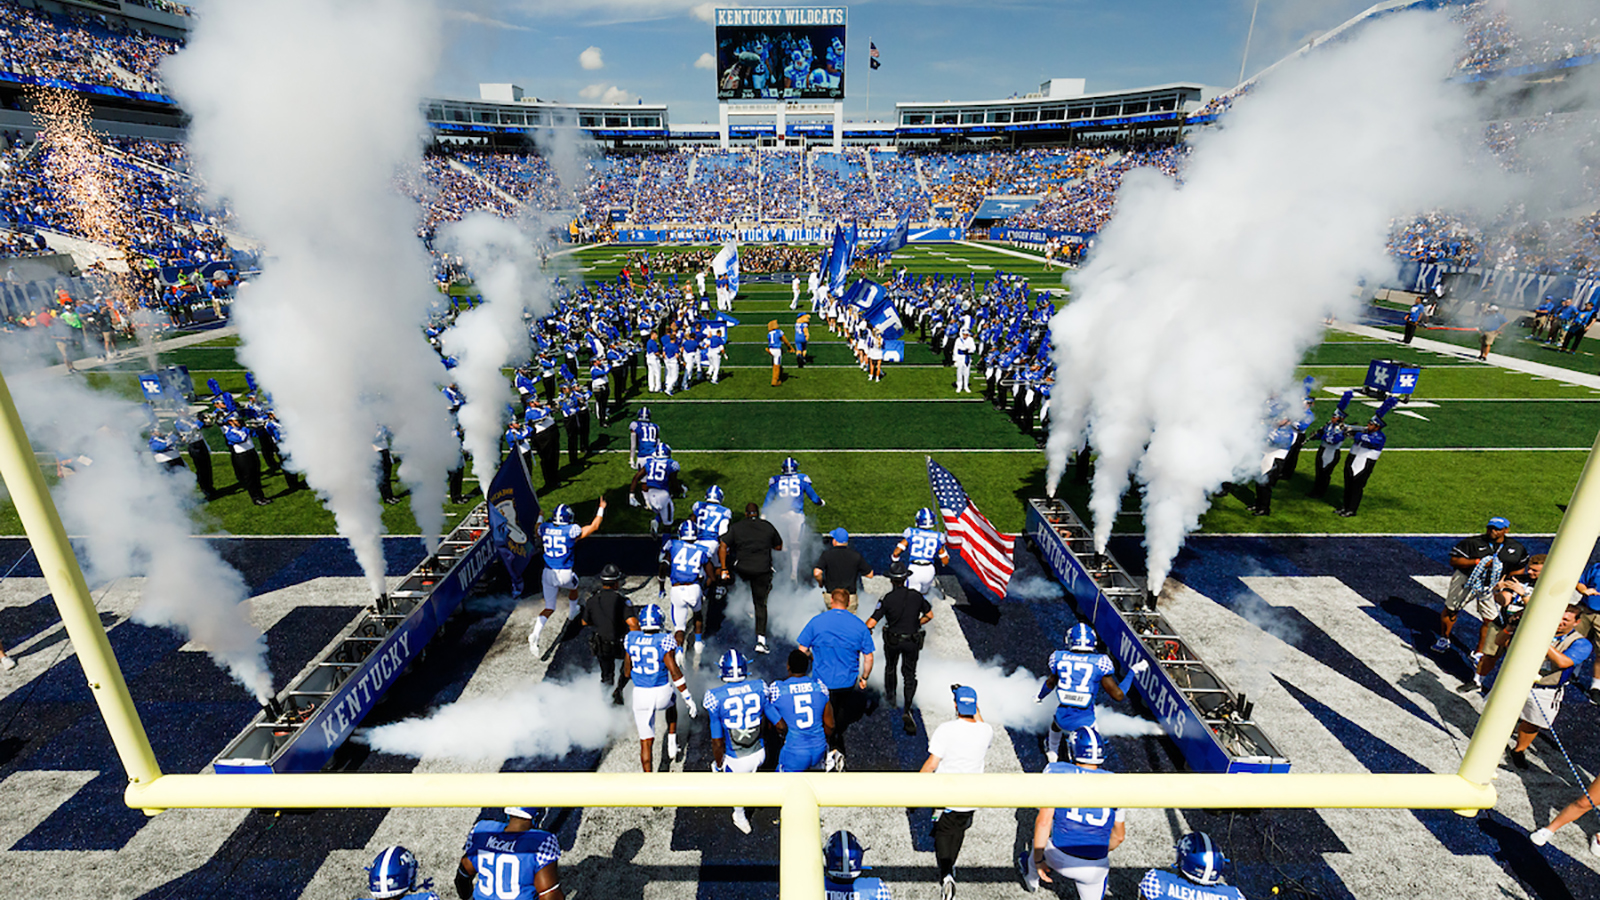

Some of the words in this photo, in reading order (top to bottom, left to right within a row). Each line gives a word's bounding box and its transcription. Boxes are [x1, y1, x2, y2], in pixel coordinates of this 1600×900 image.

[718, 10, 782, 25] KENTUCKY
[785, 9, 844, 24] WILDCATS
[784, 228, 834, 241] WILDCAT
[1029, 231, 1047, 241] FIELD
[1414, 262, 1557, 307] KEUCKY
[641, 426, 657, 442] 10
[647, 461, 667, 481] 15
[778, 478, 801, 497] 55
[697, 508, 722, 533] 27
[542, 535, 567, 558] 25
[910, 536, 938, 559] 28
[1037, 521, 1079, 590] KENTUCKY
[673, 547, 703, 574] 44
[630, 645, 660, 675] 23
[789, 682, 813, 694] PETERS
[1056, 660, 1094, 693] 37
[1120, 631, 1187, 739] WILDCATS
[320, 631, 412, 749] KENTUCKY
[723, 693, 761, 729] 32
[793, 694, 814, 729] 5
[477, 849, 521, 900] 50
